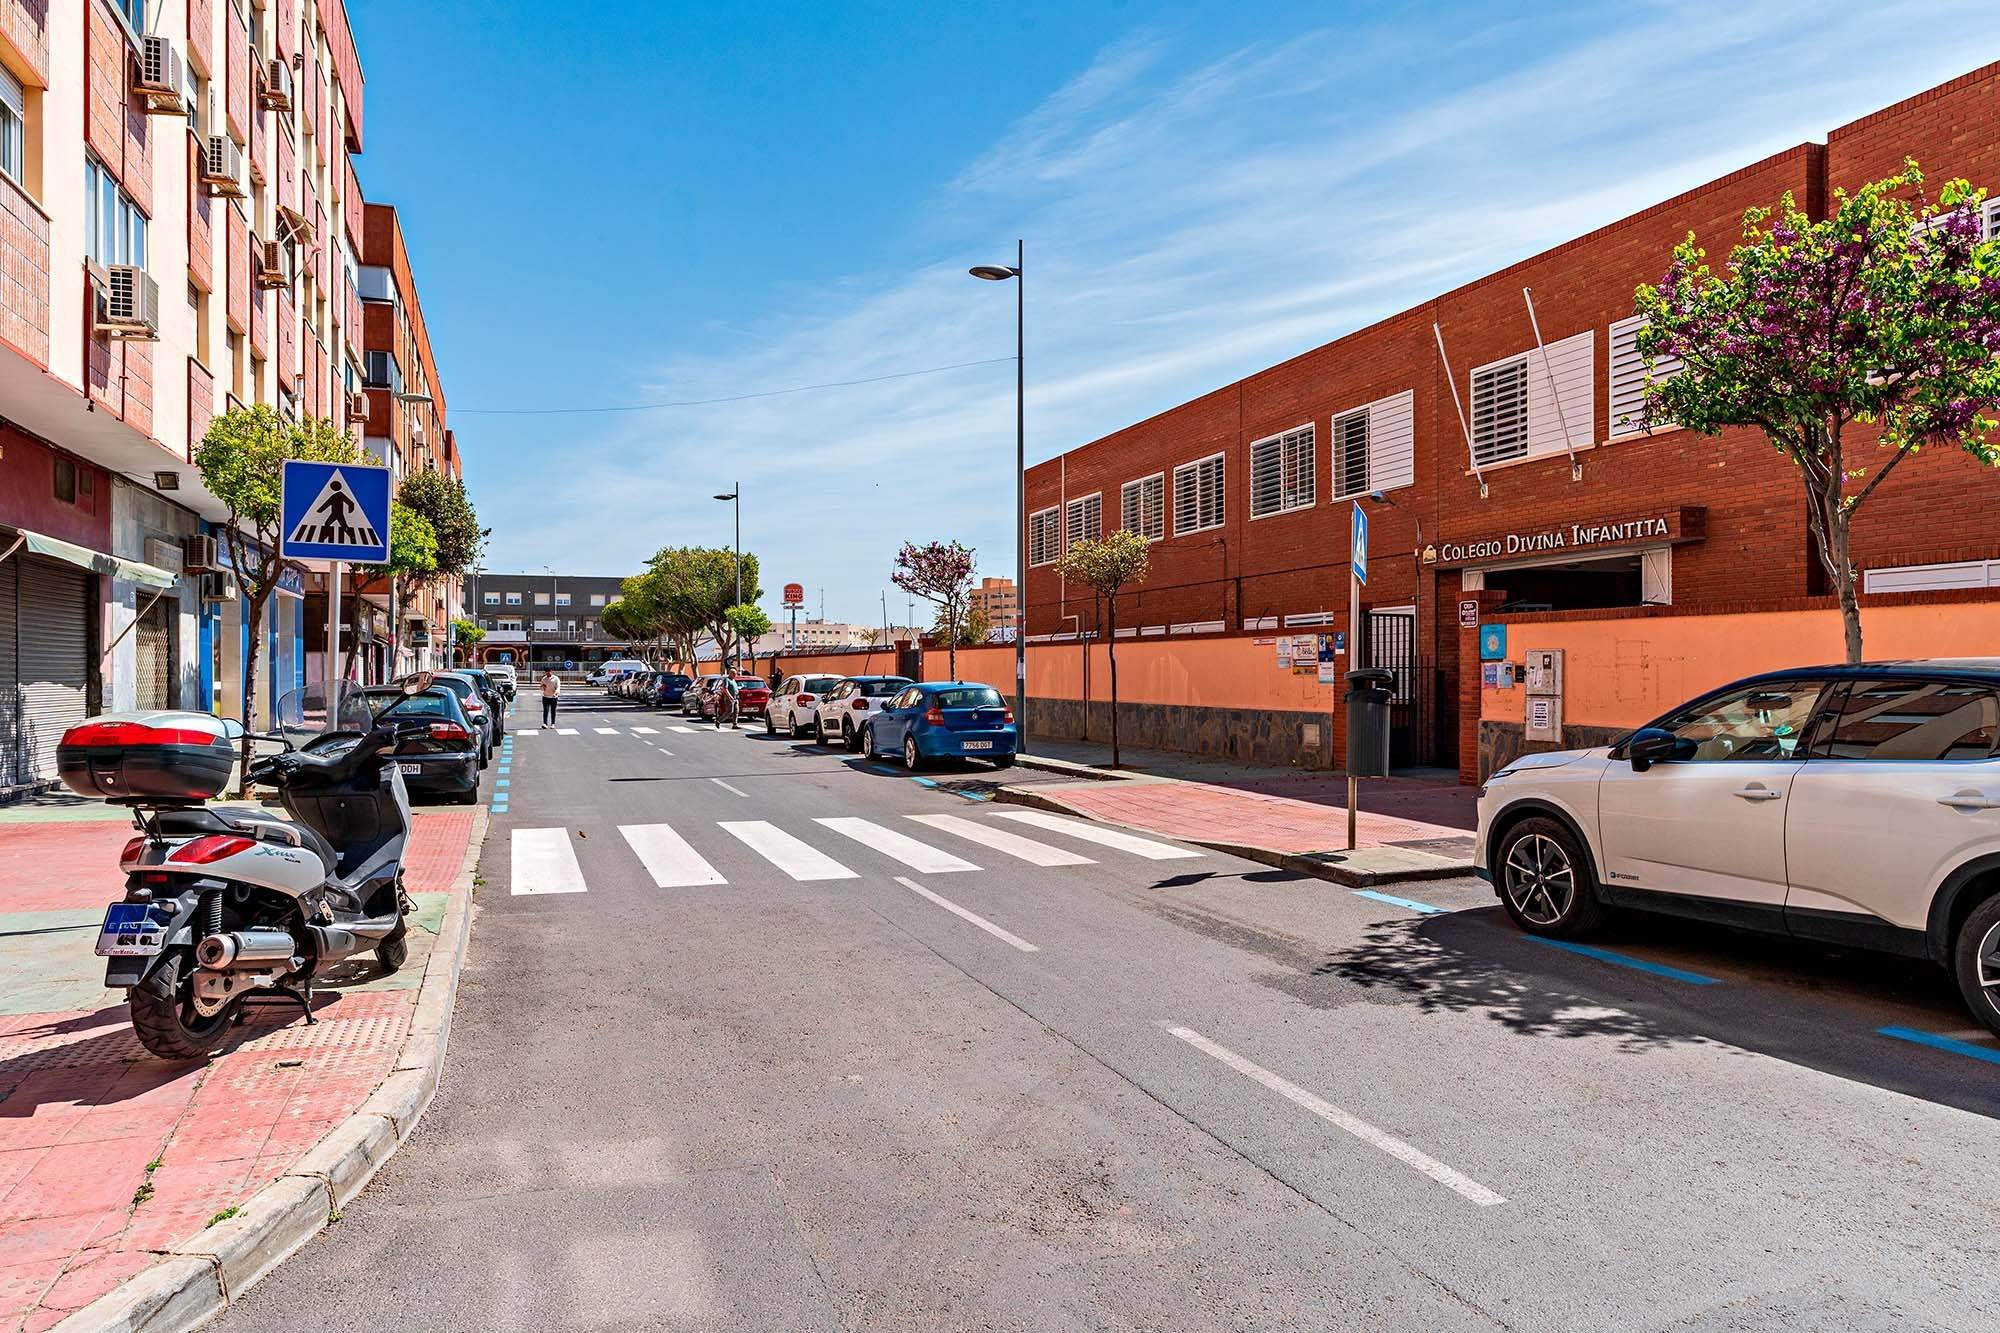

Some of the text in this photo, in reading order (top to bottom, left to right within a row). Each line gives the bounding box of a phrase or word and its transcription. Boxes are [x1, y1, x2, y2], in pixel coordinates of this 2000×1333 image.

[1441, 518, 1668, 561] COLEGIO DIVINA INFANTITA
